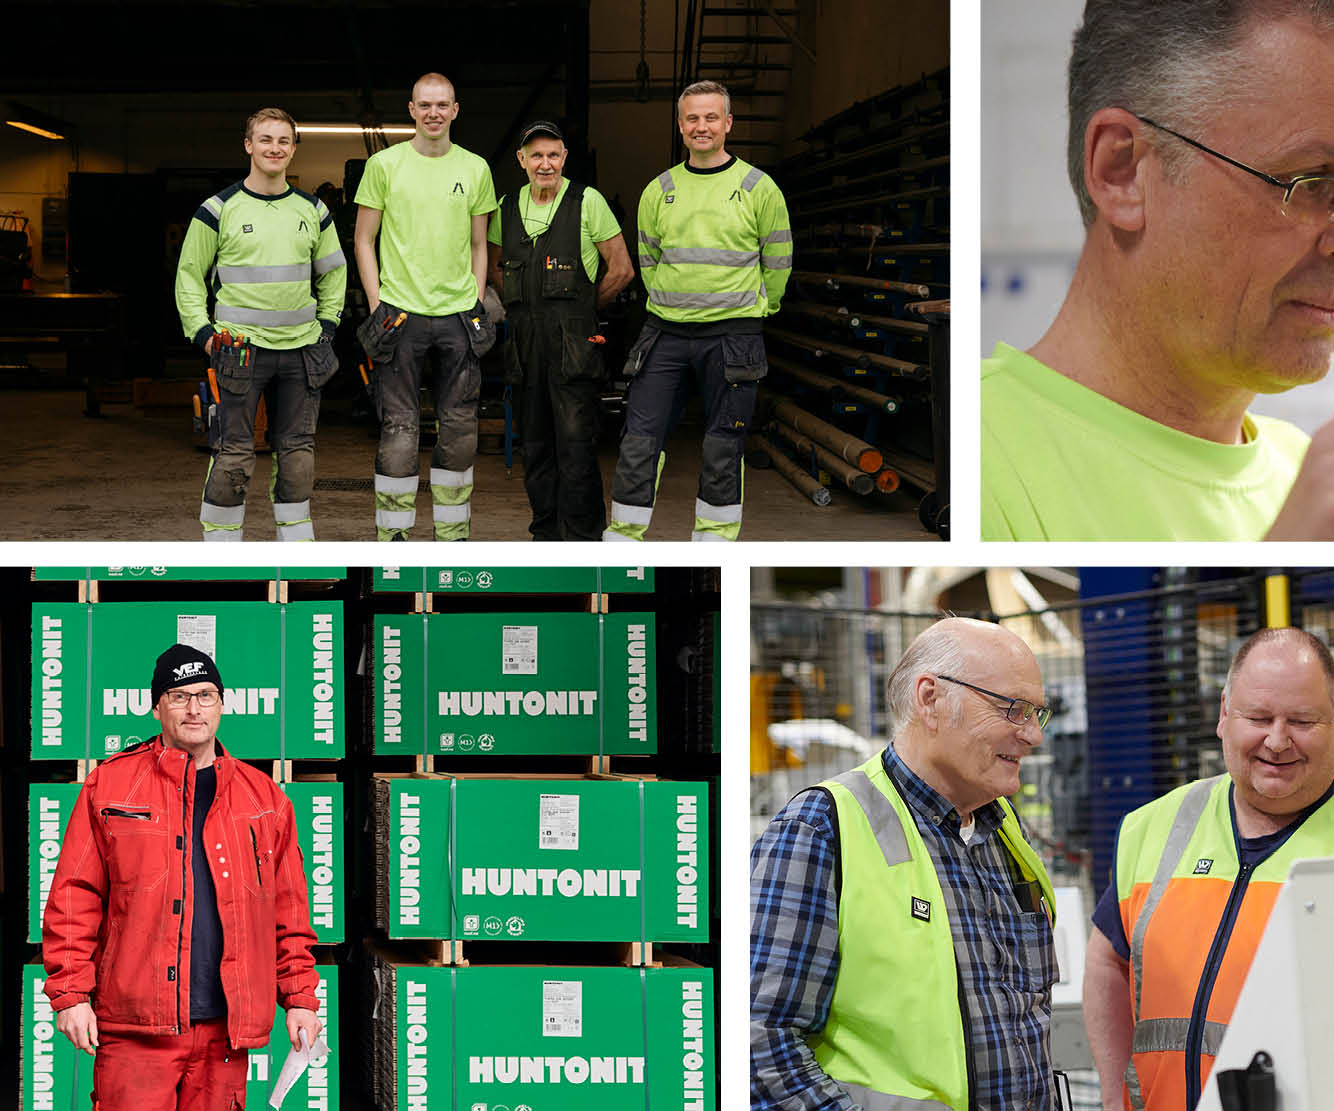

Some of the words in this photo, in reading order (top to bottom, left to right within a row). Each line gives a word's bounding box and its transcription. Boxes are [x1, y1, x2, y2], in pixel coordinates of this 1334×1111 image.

[42, 615, 62, 745] HUNTONIT
[103, 688, 279, 715] HUNIT
[313, 614, 333, 744] HUNTONIT
[383, 626, 401, 742] HUNTONIT
[439, 691, 597, 716] HUNTONIT
[628, 624, 647, 741] HUNTONIT
[312, 796, 333, 928] HUNTONIT
[400, 793, 420, 925] HUNTONIT
[462, 868, 640, 897] HUNTONIT
[676, 796, 698, 928] HUNTONIT
[33, 978, 54, 1110] HUNTONIT
[407, 981, 428, 1111] HUNTONIT
[469, 1056, 644, 1083] HUNTONIT
[682, 982, 704, 1111] HUNTONIT
